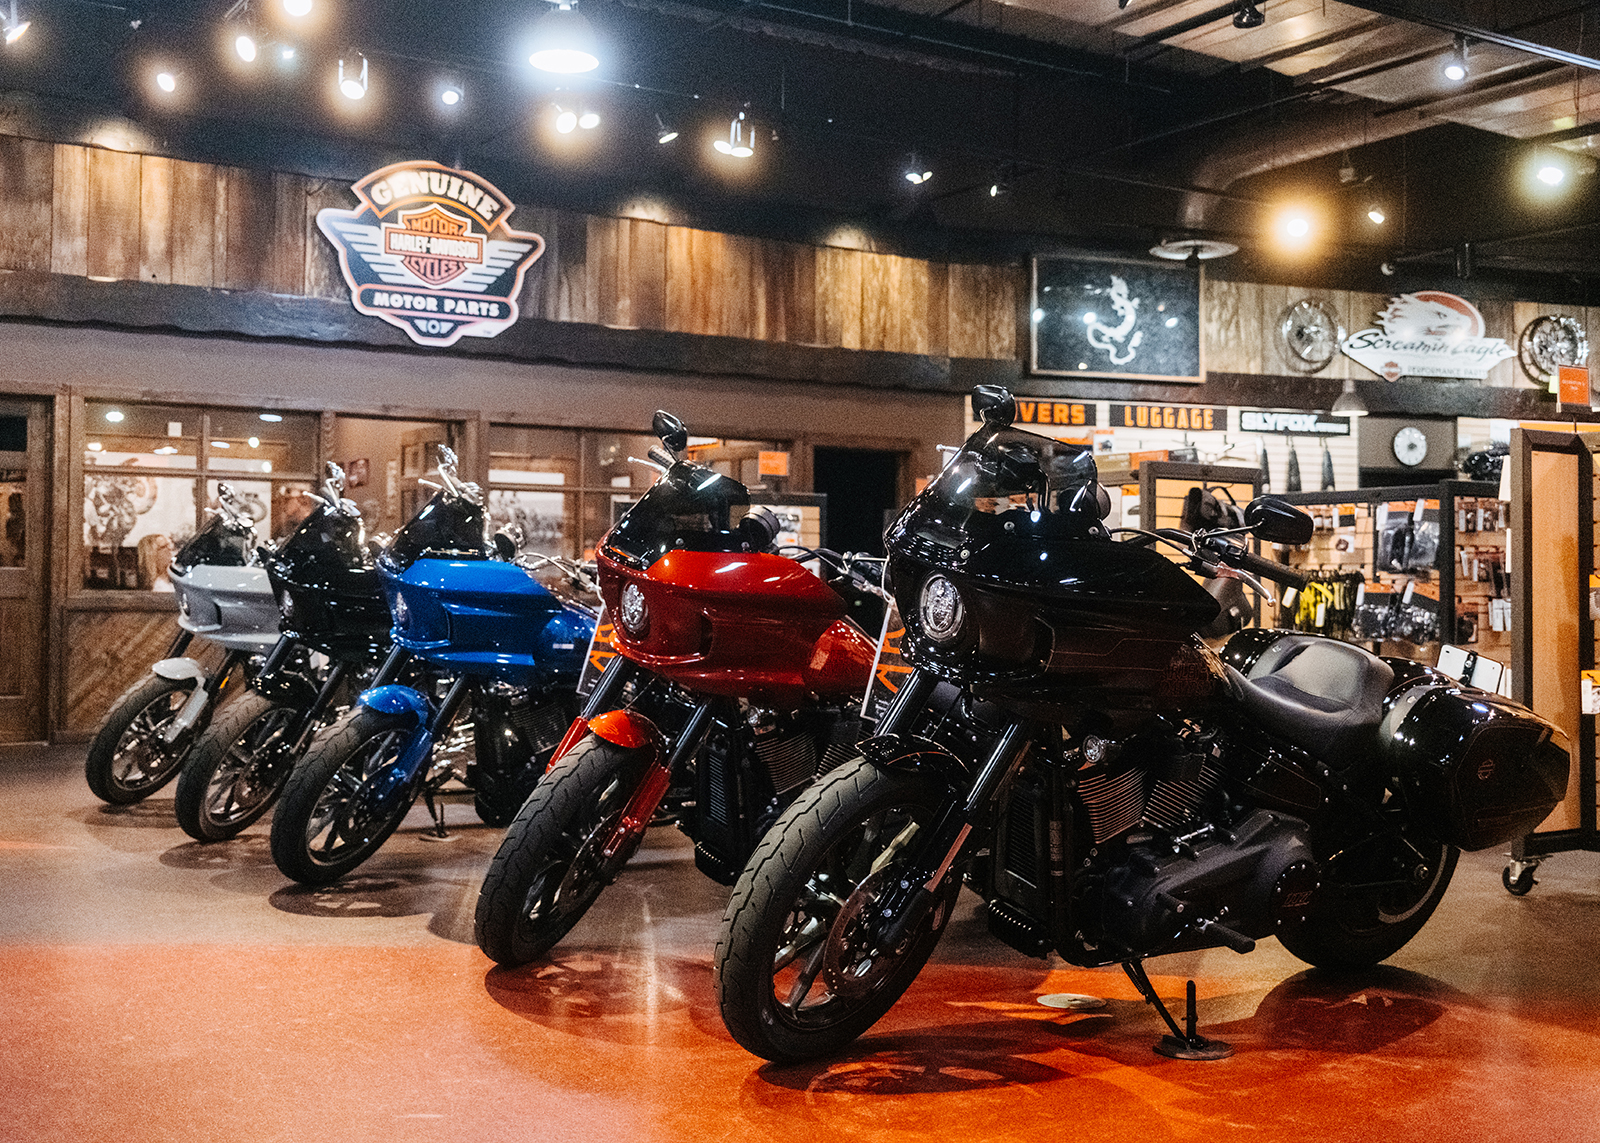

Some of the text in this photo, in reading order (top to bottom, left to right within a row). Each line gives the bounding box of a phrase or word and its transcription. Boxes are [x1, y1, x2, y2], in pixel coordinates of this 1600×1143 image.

[371, 170, 500, 220] GENUINE
[411, 216, 459, 235] MOTOR
[390, 232, 478, 259] HARLEY-DAVIDSON
[410, 257, 458, 281] CYCLES
[373, 292, 500, 317] MOTOR PARTS
[1450, 338, 1508, 362] Eagle
[1407, 365, 1461, 376] PERFORMANCE
[1014, 401, 1086, 425] VERS
[1124, 405, 1213, 430] LUGGAGE
[1241, 411, 1318, 432] SLYFOX
